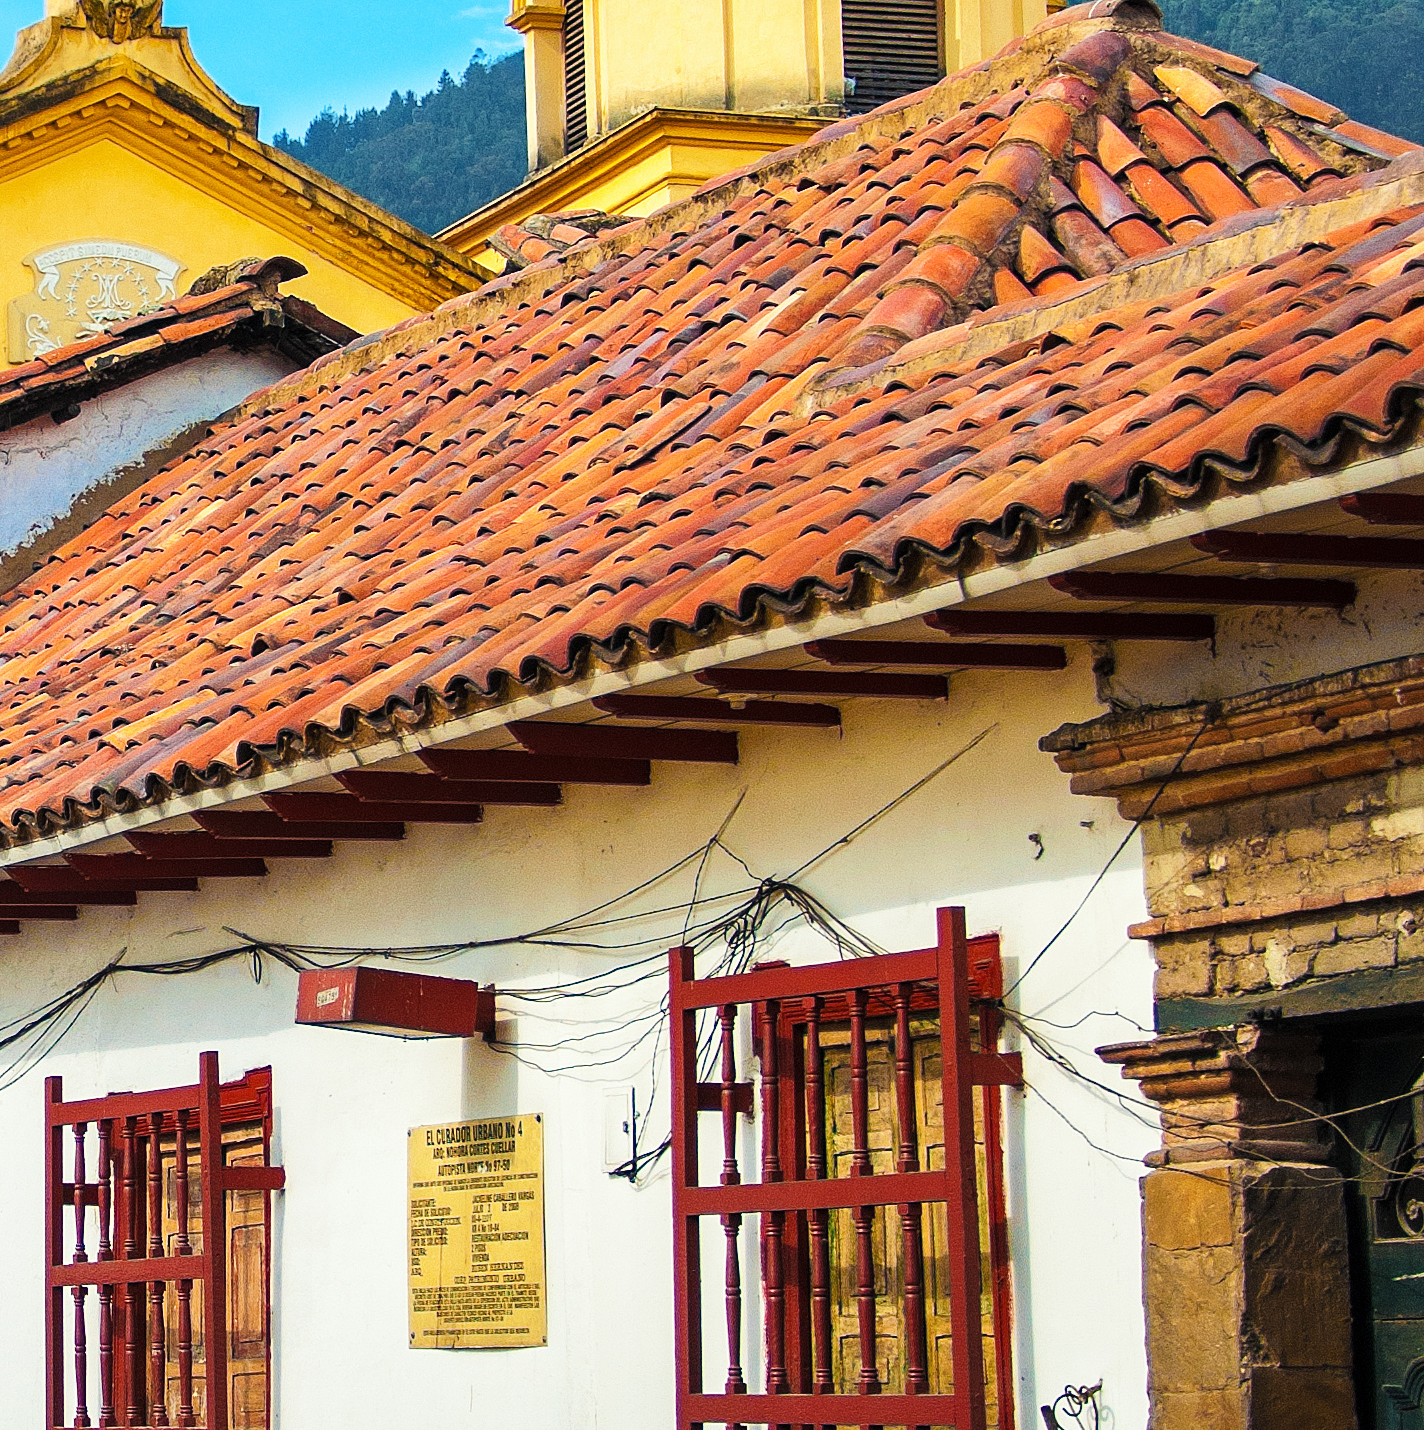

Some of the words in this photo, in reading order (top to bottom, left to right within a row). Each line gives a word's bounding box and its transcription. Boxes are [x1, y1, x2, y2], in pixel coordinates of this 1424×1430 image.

[436, 1125, 471, 1145] CURADOR
[472, 1122, 503, 1142] URBANO
[517, 1120, 523, 1137] 4
[490, 1140, 515, 1155] CUELLAR
